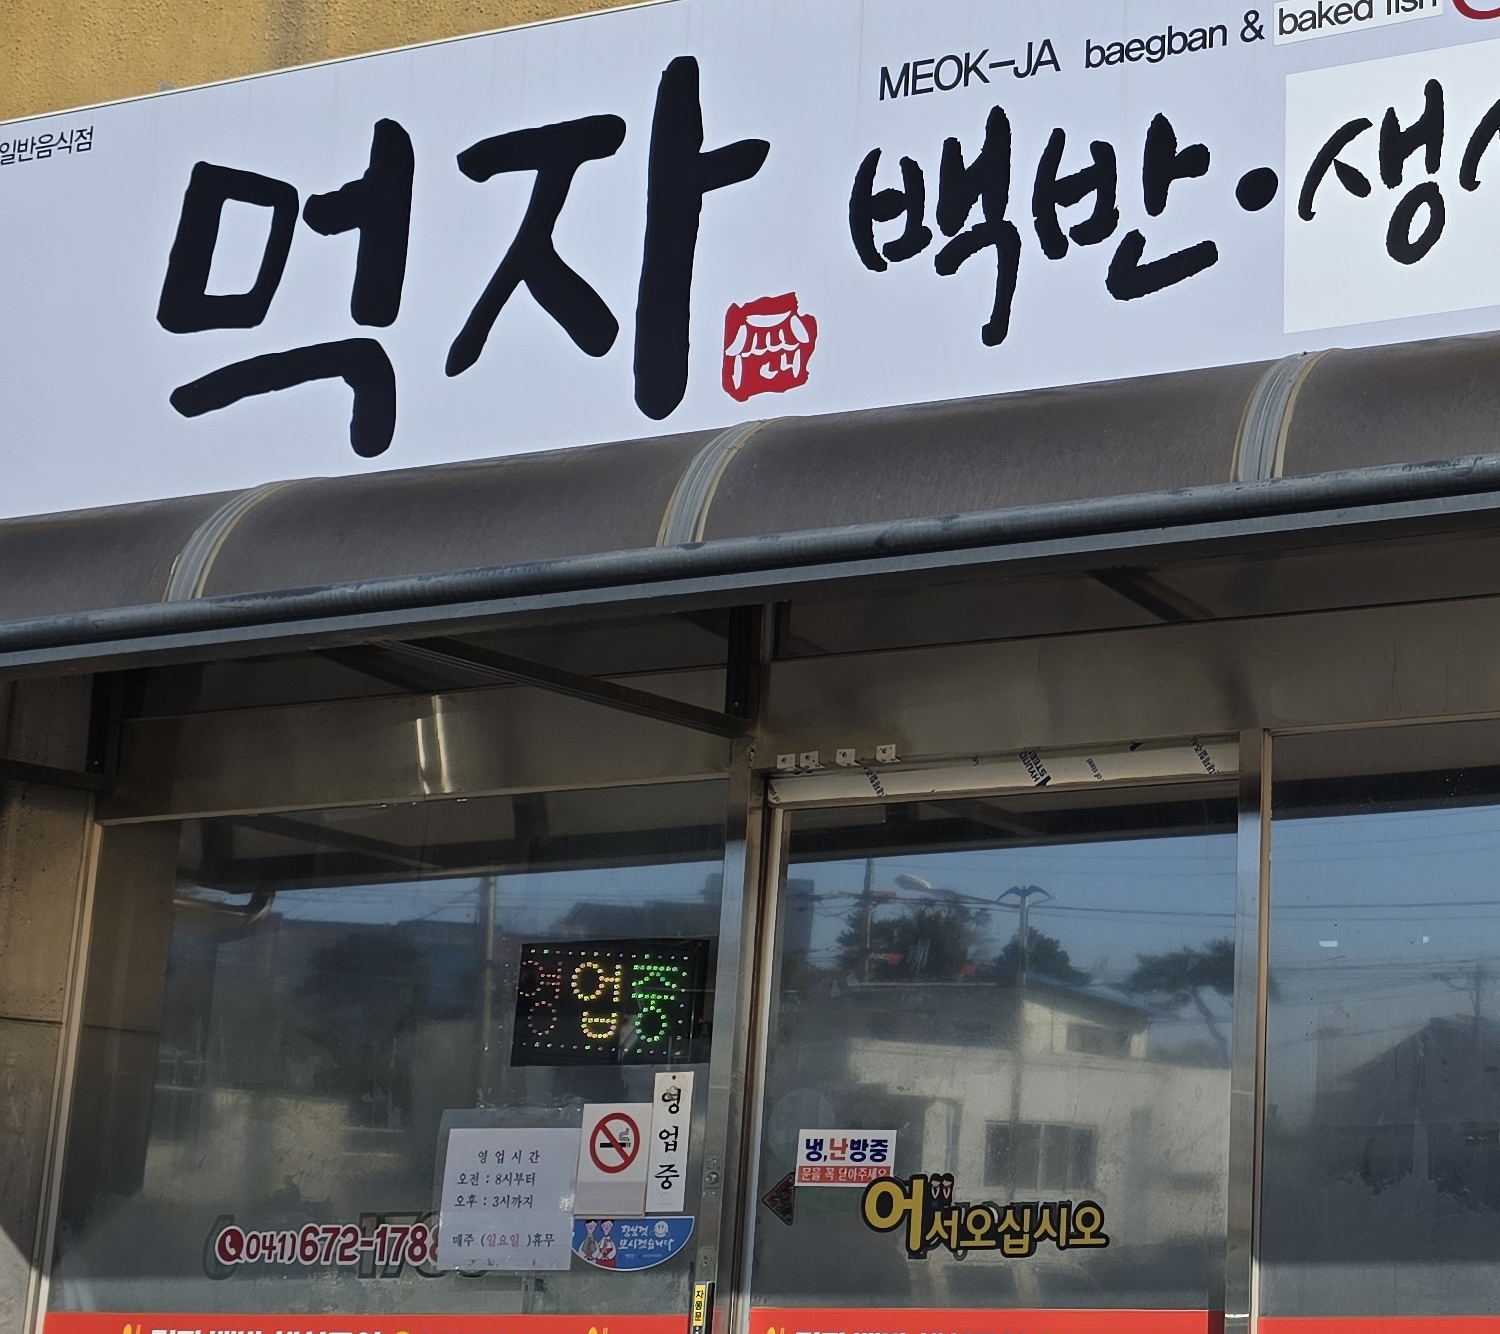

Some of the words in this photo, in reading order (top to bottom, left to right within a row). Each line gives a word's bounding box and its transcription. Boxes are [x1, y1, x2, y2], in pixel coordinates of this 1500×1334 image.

[879, 38, 1062, 101] MEOK-JA
[1084, 24, 1228, 69] baegban
[1240, 9, 1266, 43] &
[0, 126, 94, 166] 일반음식점
[157, 55, 770, 458] 먹자
[519, 959, 680, 1043] 영업중
[654, 1087, 681, 1190] 영업중
[805, 1137, 889, 1163] 냉,난방중
[454, 1193, 478, 1208] 오후
[457, 1172, 480, 1186] 오전
[864, 1177, 1107, 1255] 어서오십시오
